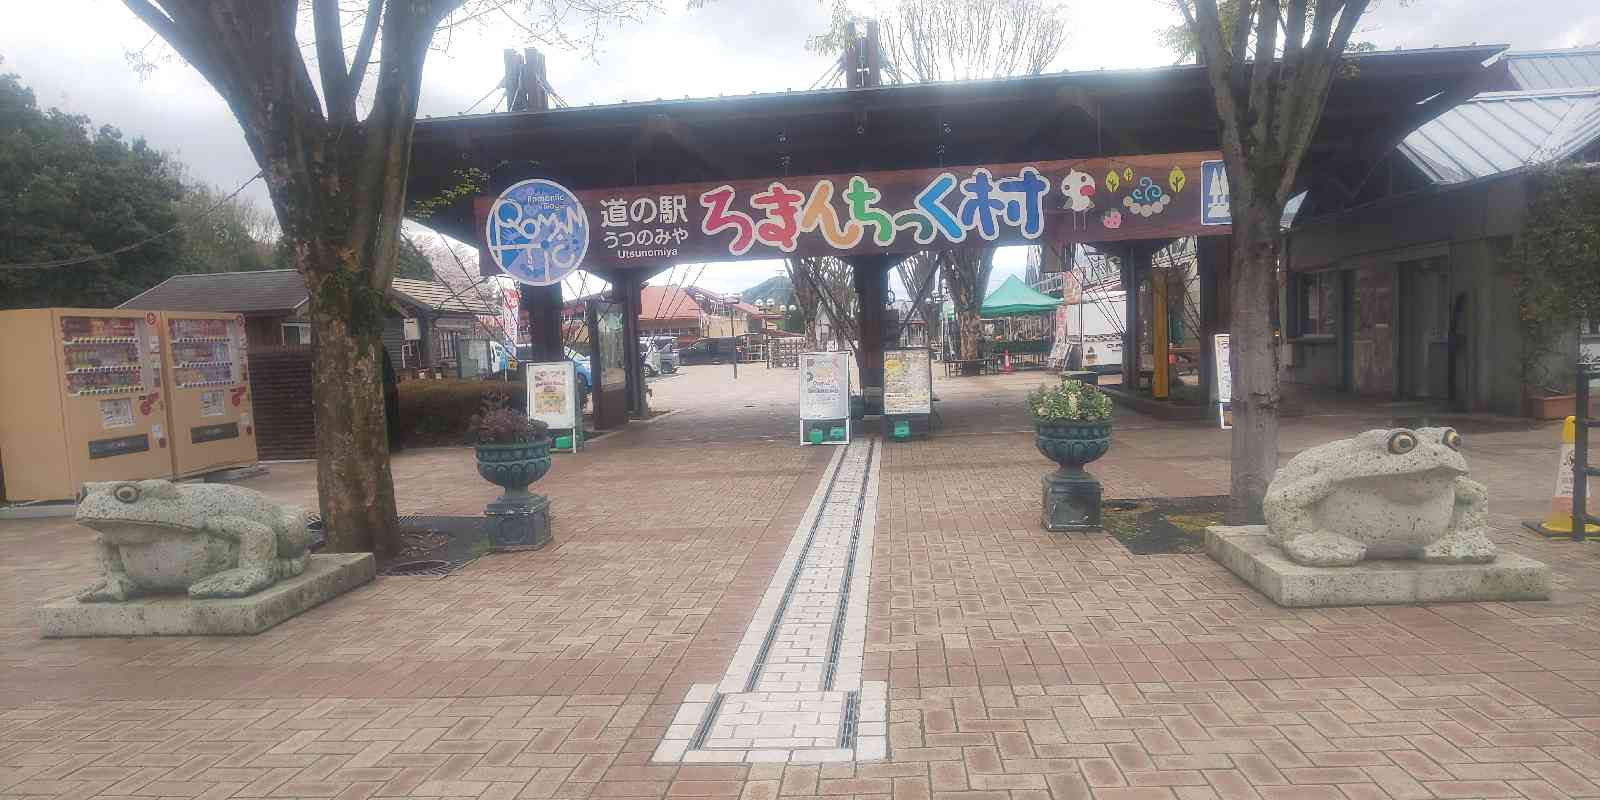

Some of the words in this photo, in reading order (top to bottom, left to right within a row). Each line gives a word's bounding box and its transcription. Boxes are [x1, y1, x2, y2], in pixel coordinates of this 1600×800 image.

[600, 195, 688, 228] 道の駅
[701, 167, 1049, 256] ろまんちっく村
[603, 228, 689, 248] うつのみや
[617, 248, 679, 258] Utsunomiya
